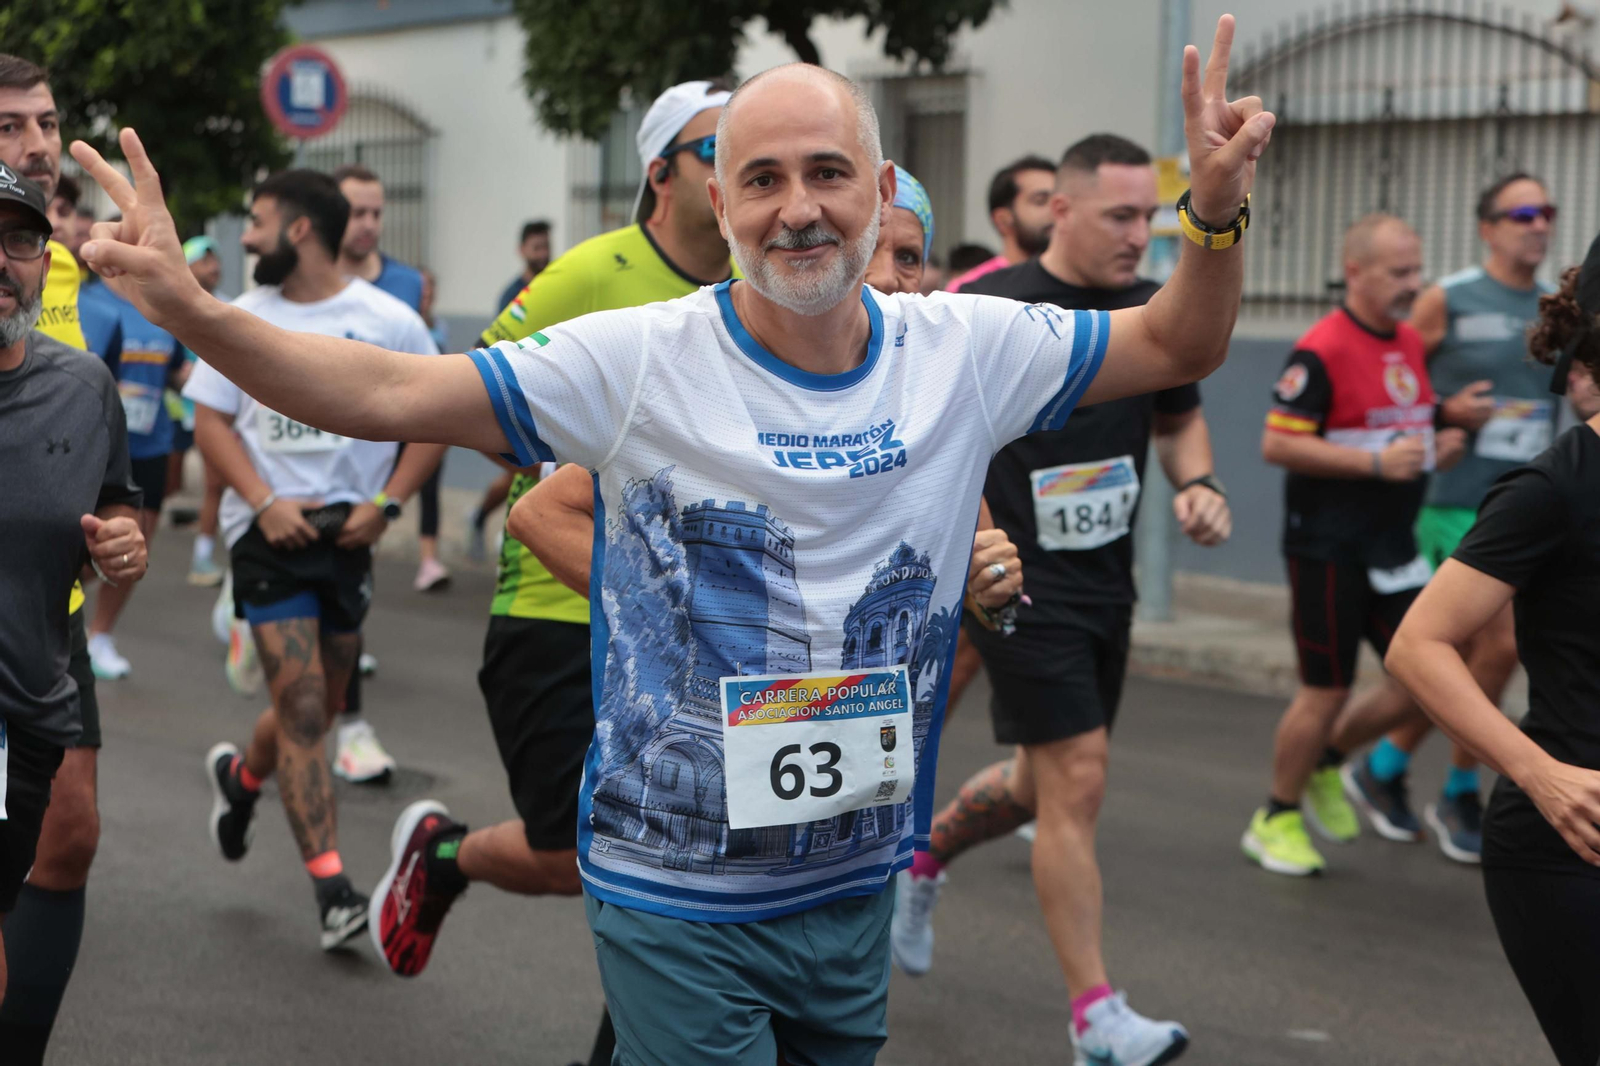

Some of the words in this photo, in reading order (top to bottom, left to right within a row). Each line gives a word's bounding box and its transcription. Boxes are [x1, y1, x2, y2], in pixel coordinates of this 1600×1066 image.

[757, 432, 809, 448] MEDIO
[813, 418, 894, 448] MARATÓN
[849, 449, 908, 479] 2024
[1052, 501, 1111, 535] 184
[740, 687, 822, 705] CARRERA
[827, 681, 897, 701] POPULAR
[737, 706, 821, 721] ASOCIACION
[824, 702, 865, 716] SANTO
[868, 699, 904, 712] ANGEL
[769, 741, 843, 800] 63
